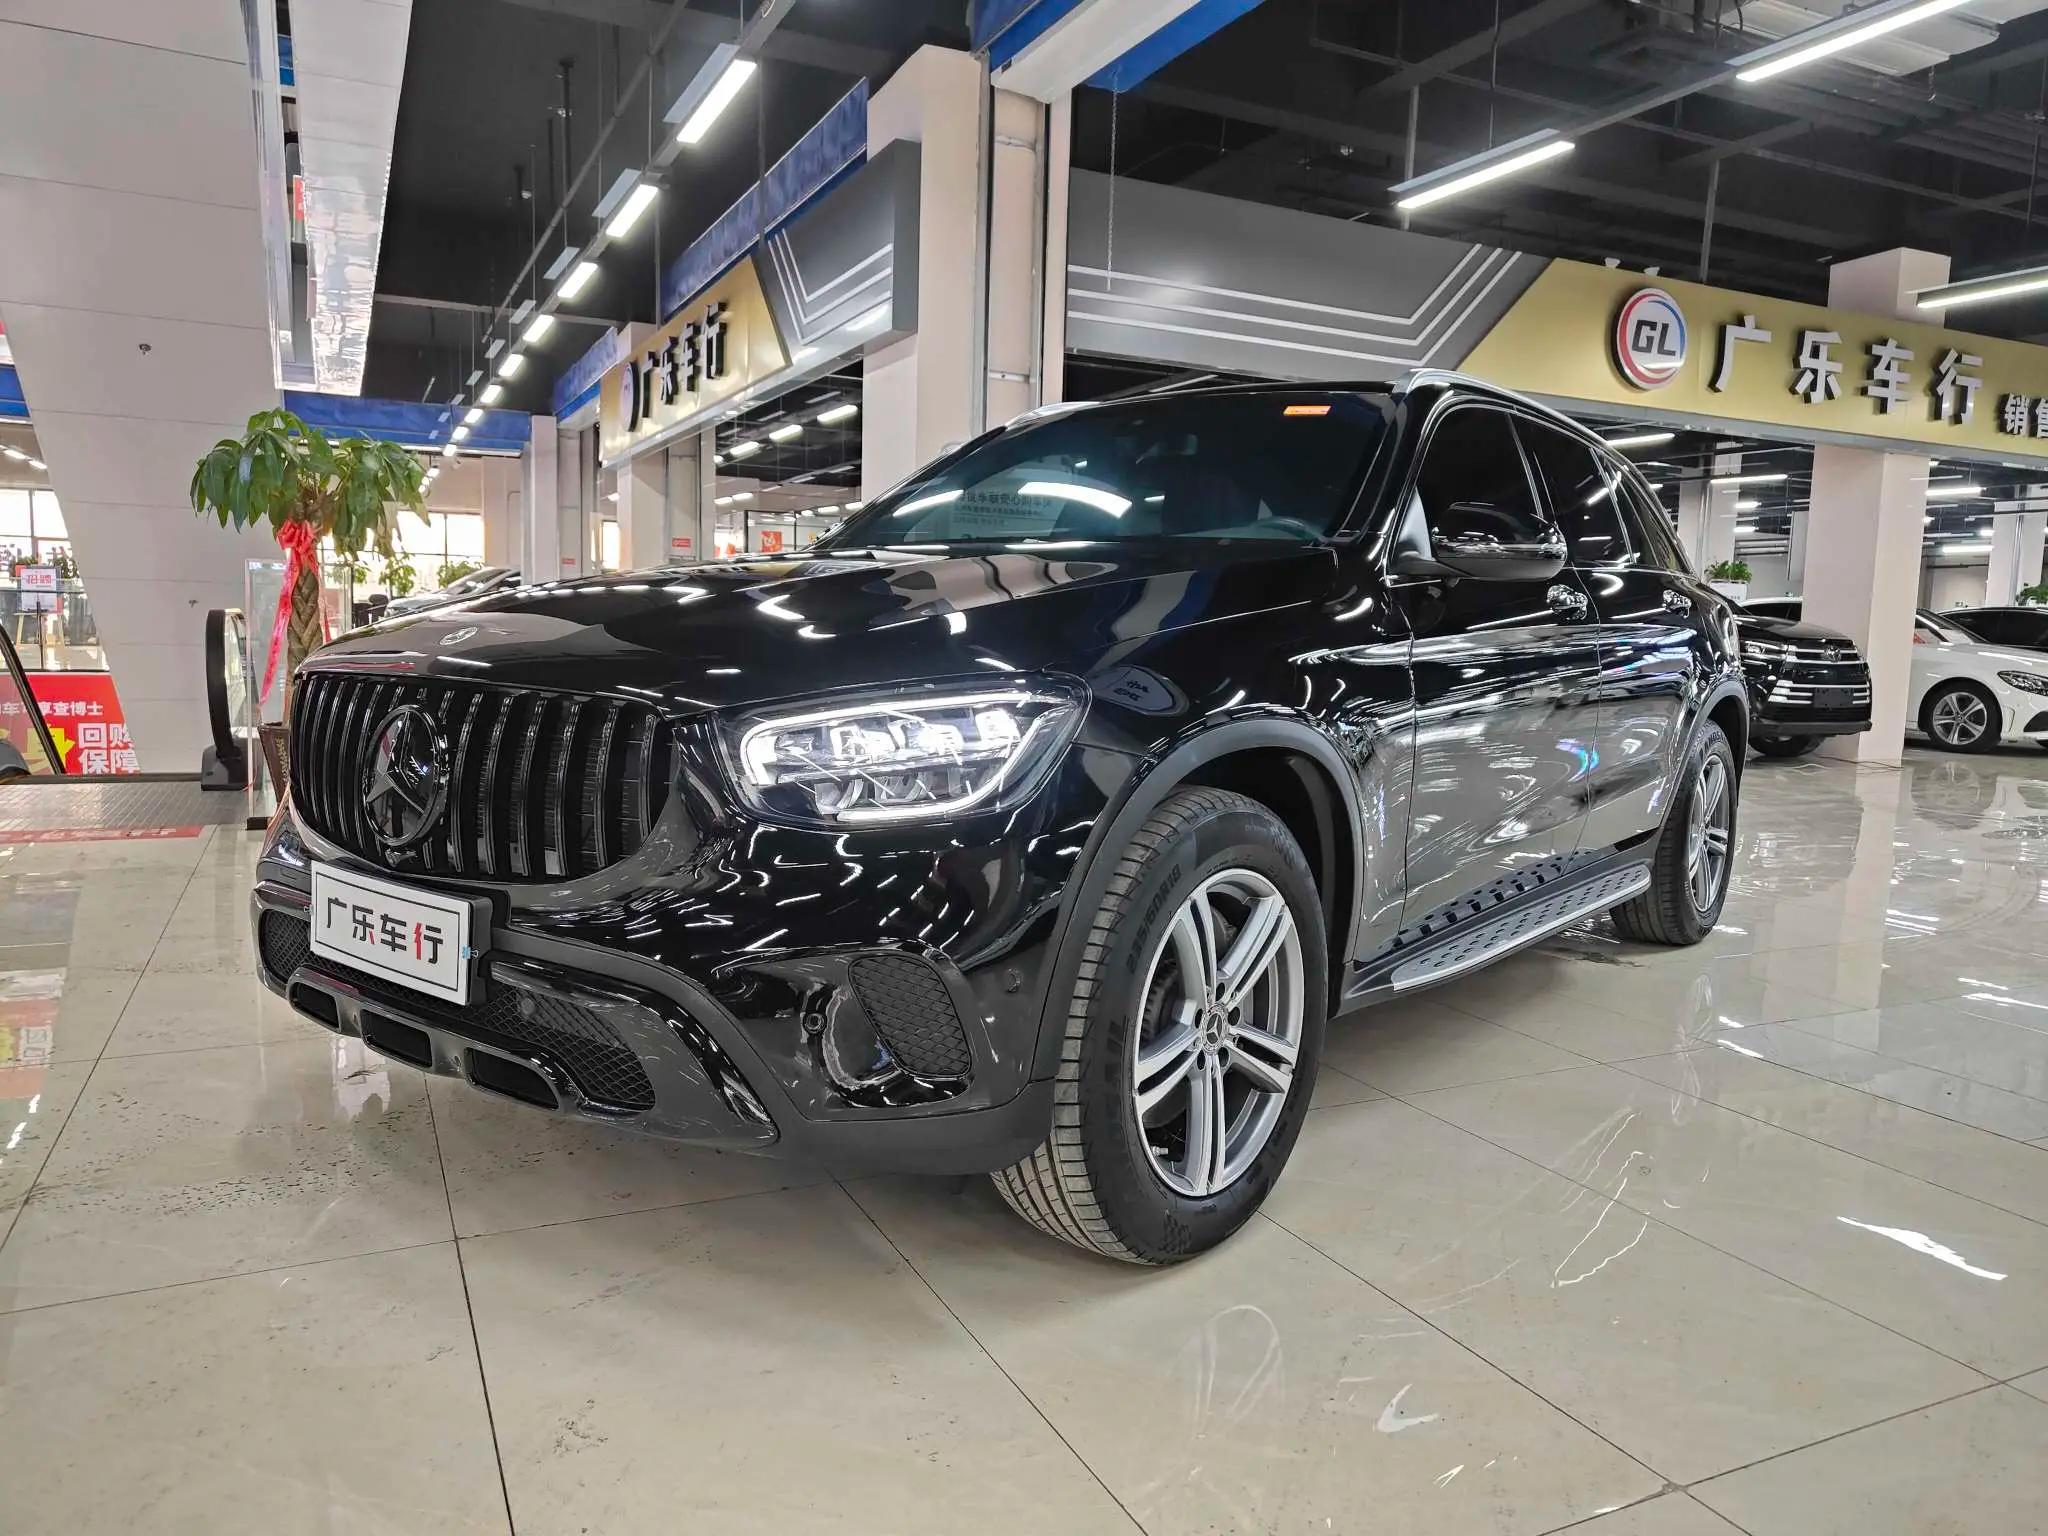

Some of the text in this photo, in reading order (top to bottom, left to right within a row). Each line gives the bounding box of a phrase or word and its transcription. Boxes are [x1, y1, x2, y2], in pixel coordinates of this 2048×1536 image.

[1632, 318, 1677, 357] GL
[1710, 314, 1984, 426] 广乐车行
[77, 722, 135, 750] 回购
[78, 748, 141, 774] 保障
[326, 896, 444, 965] 广乐车行
